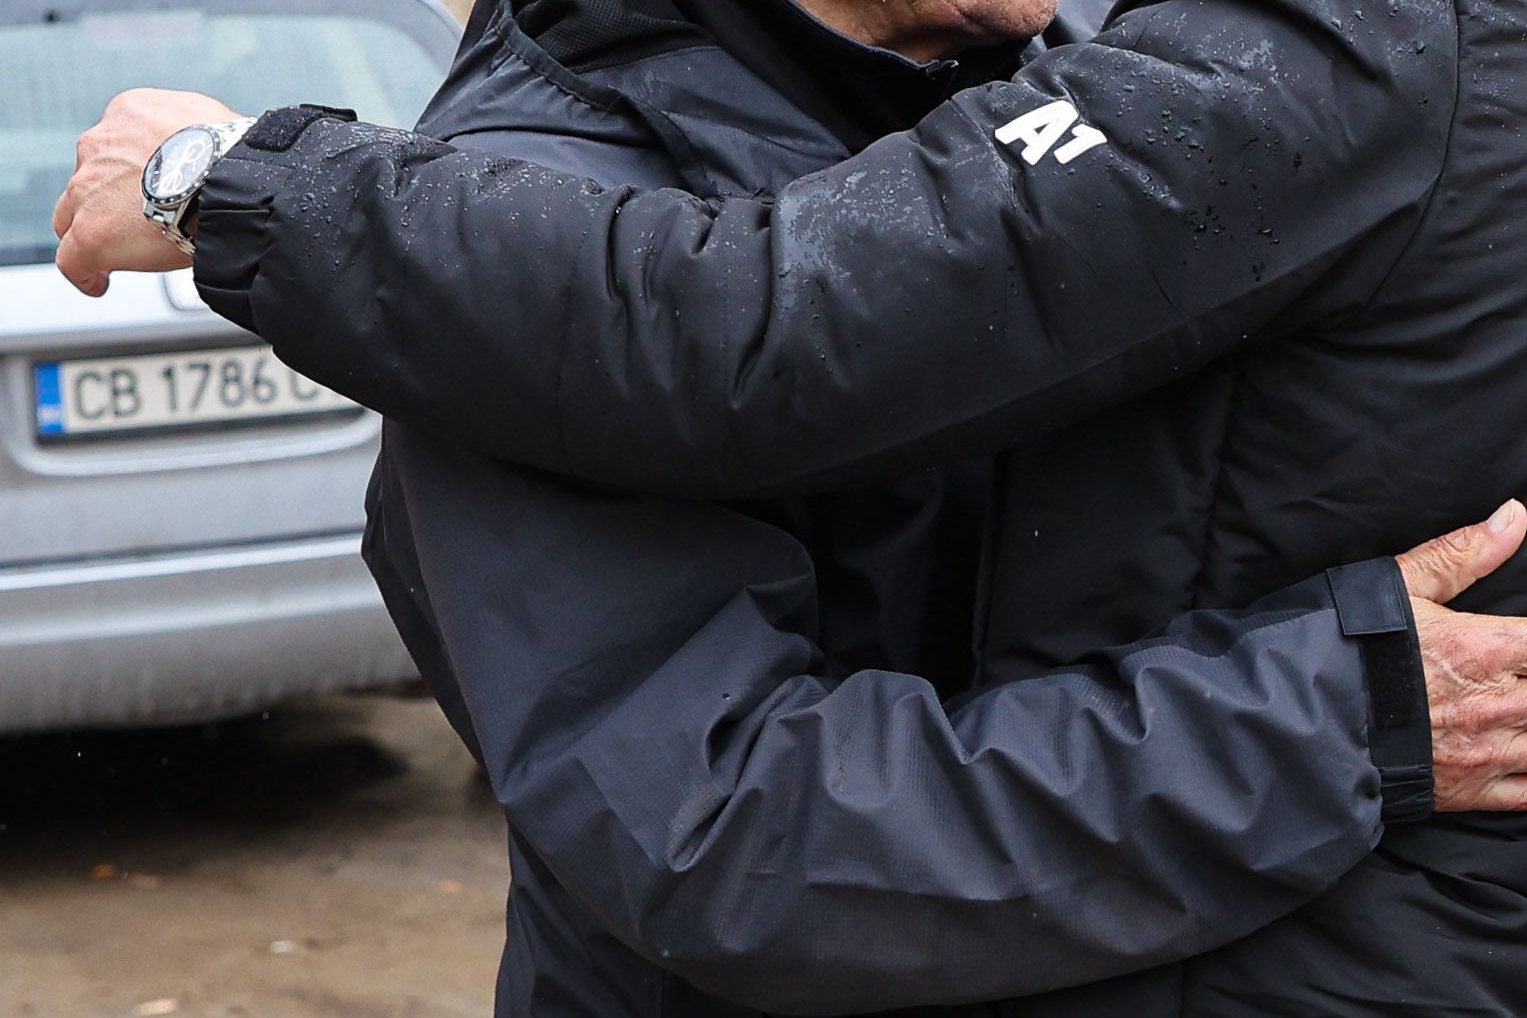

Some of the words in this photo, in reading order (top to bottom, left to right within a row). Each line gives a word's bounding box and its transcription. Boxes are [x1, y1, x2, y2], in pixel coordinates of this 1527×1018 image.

[995, 99, 1108, 165] A1
[74, 368, 141, 420] CB
[162, 356, 277, 412] 1786
